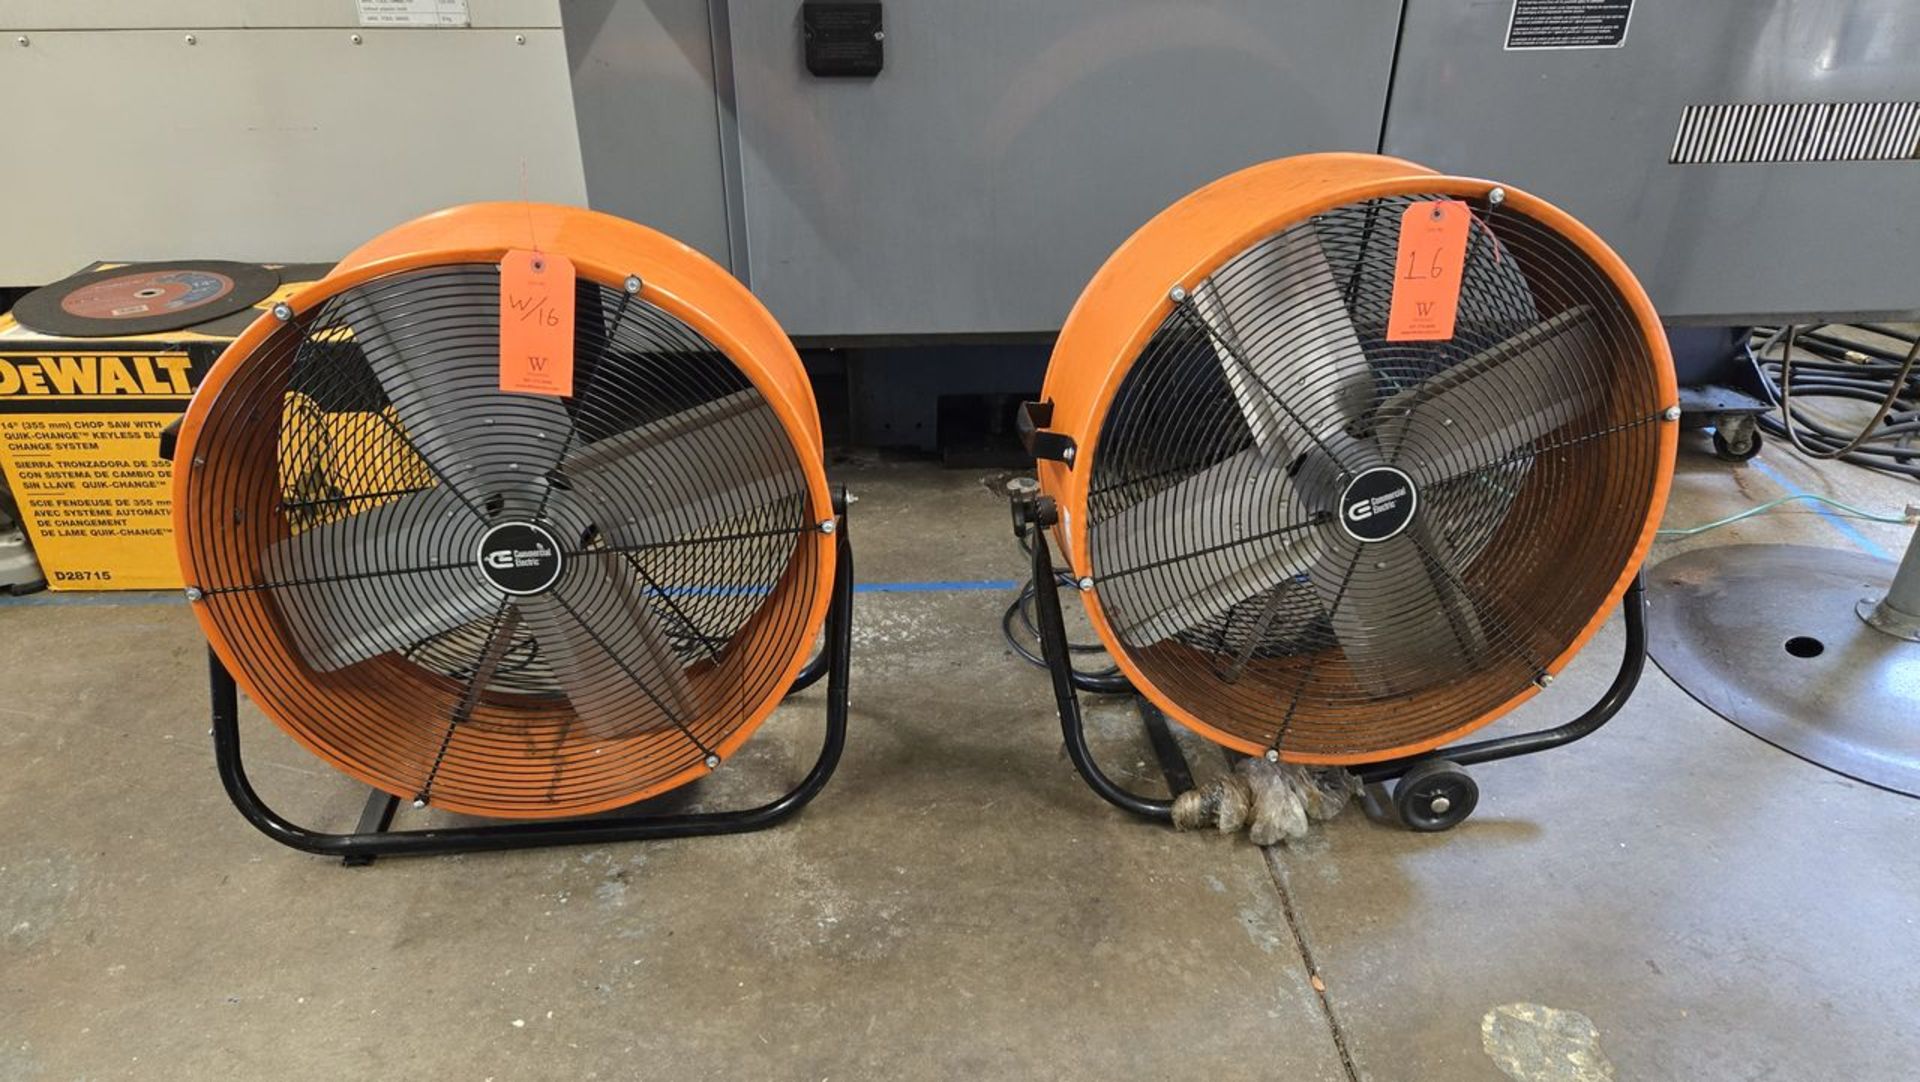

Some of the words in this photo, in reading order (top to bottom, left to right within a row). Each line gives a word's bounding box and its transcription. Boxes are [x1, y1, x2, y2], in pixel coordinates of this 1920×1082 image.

[1415, 301, 1436, 317] W
[527, 356, 549, 371] W
[22, 420, 46, 431] (355
[74, 420, 104, 430] CHOP
[107, 420, 131, 429] SAW
[133, 420, 162, 429] WITH
[92, 431, 142, 440] KEYLESS
[8, 442, 53, 451] CHANGE
[55, 442, 100, 451] SYSTEM
[14, 460, 54, 469] SIERRA
[57, 460, 130, 469] TRONZADORA
[133, 460, 149, 468] DE
[151, 460, 172, 468] 355
[18, 471, 42, 480] CON
[45, 471, 92, 480] SISTEMA
[94, 471, 109, 479] DE
[112, 470, 154, 479] CAMBIO
[158, 470, 172, 478] DE
[23, 482, 41, 491] SIN
[43, 481, 76, 490] LLAVE
[1371, 486, 1406, 506] Commercial
[29, 499, 53, 508] SCIE
[57, 498, 113, 508] FENDEUSE
[115, 498, 132, 507] DE
[133, 498, 154, 507] 355
[34, 509, 61, 518] AVEC
[37, 519, 54, 528] DE
[55, 518, 128, 528] CHANGEMENT
[40, 529, 56, 538] DE
[59, 529, 88, 537] LAME
[54, 571, 112, 581] D28715
